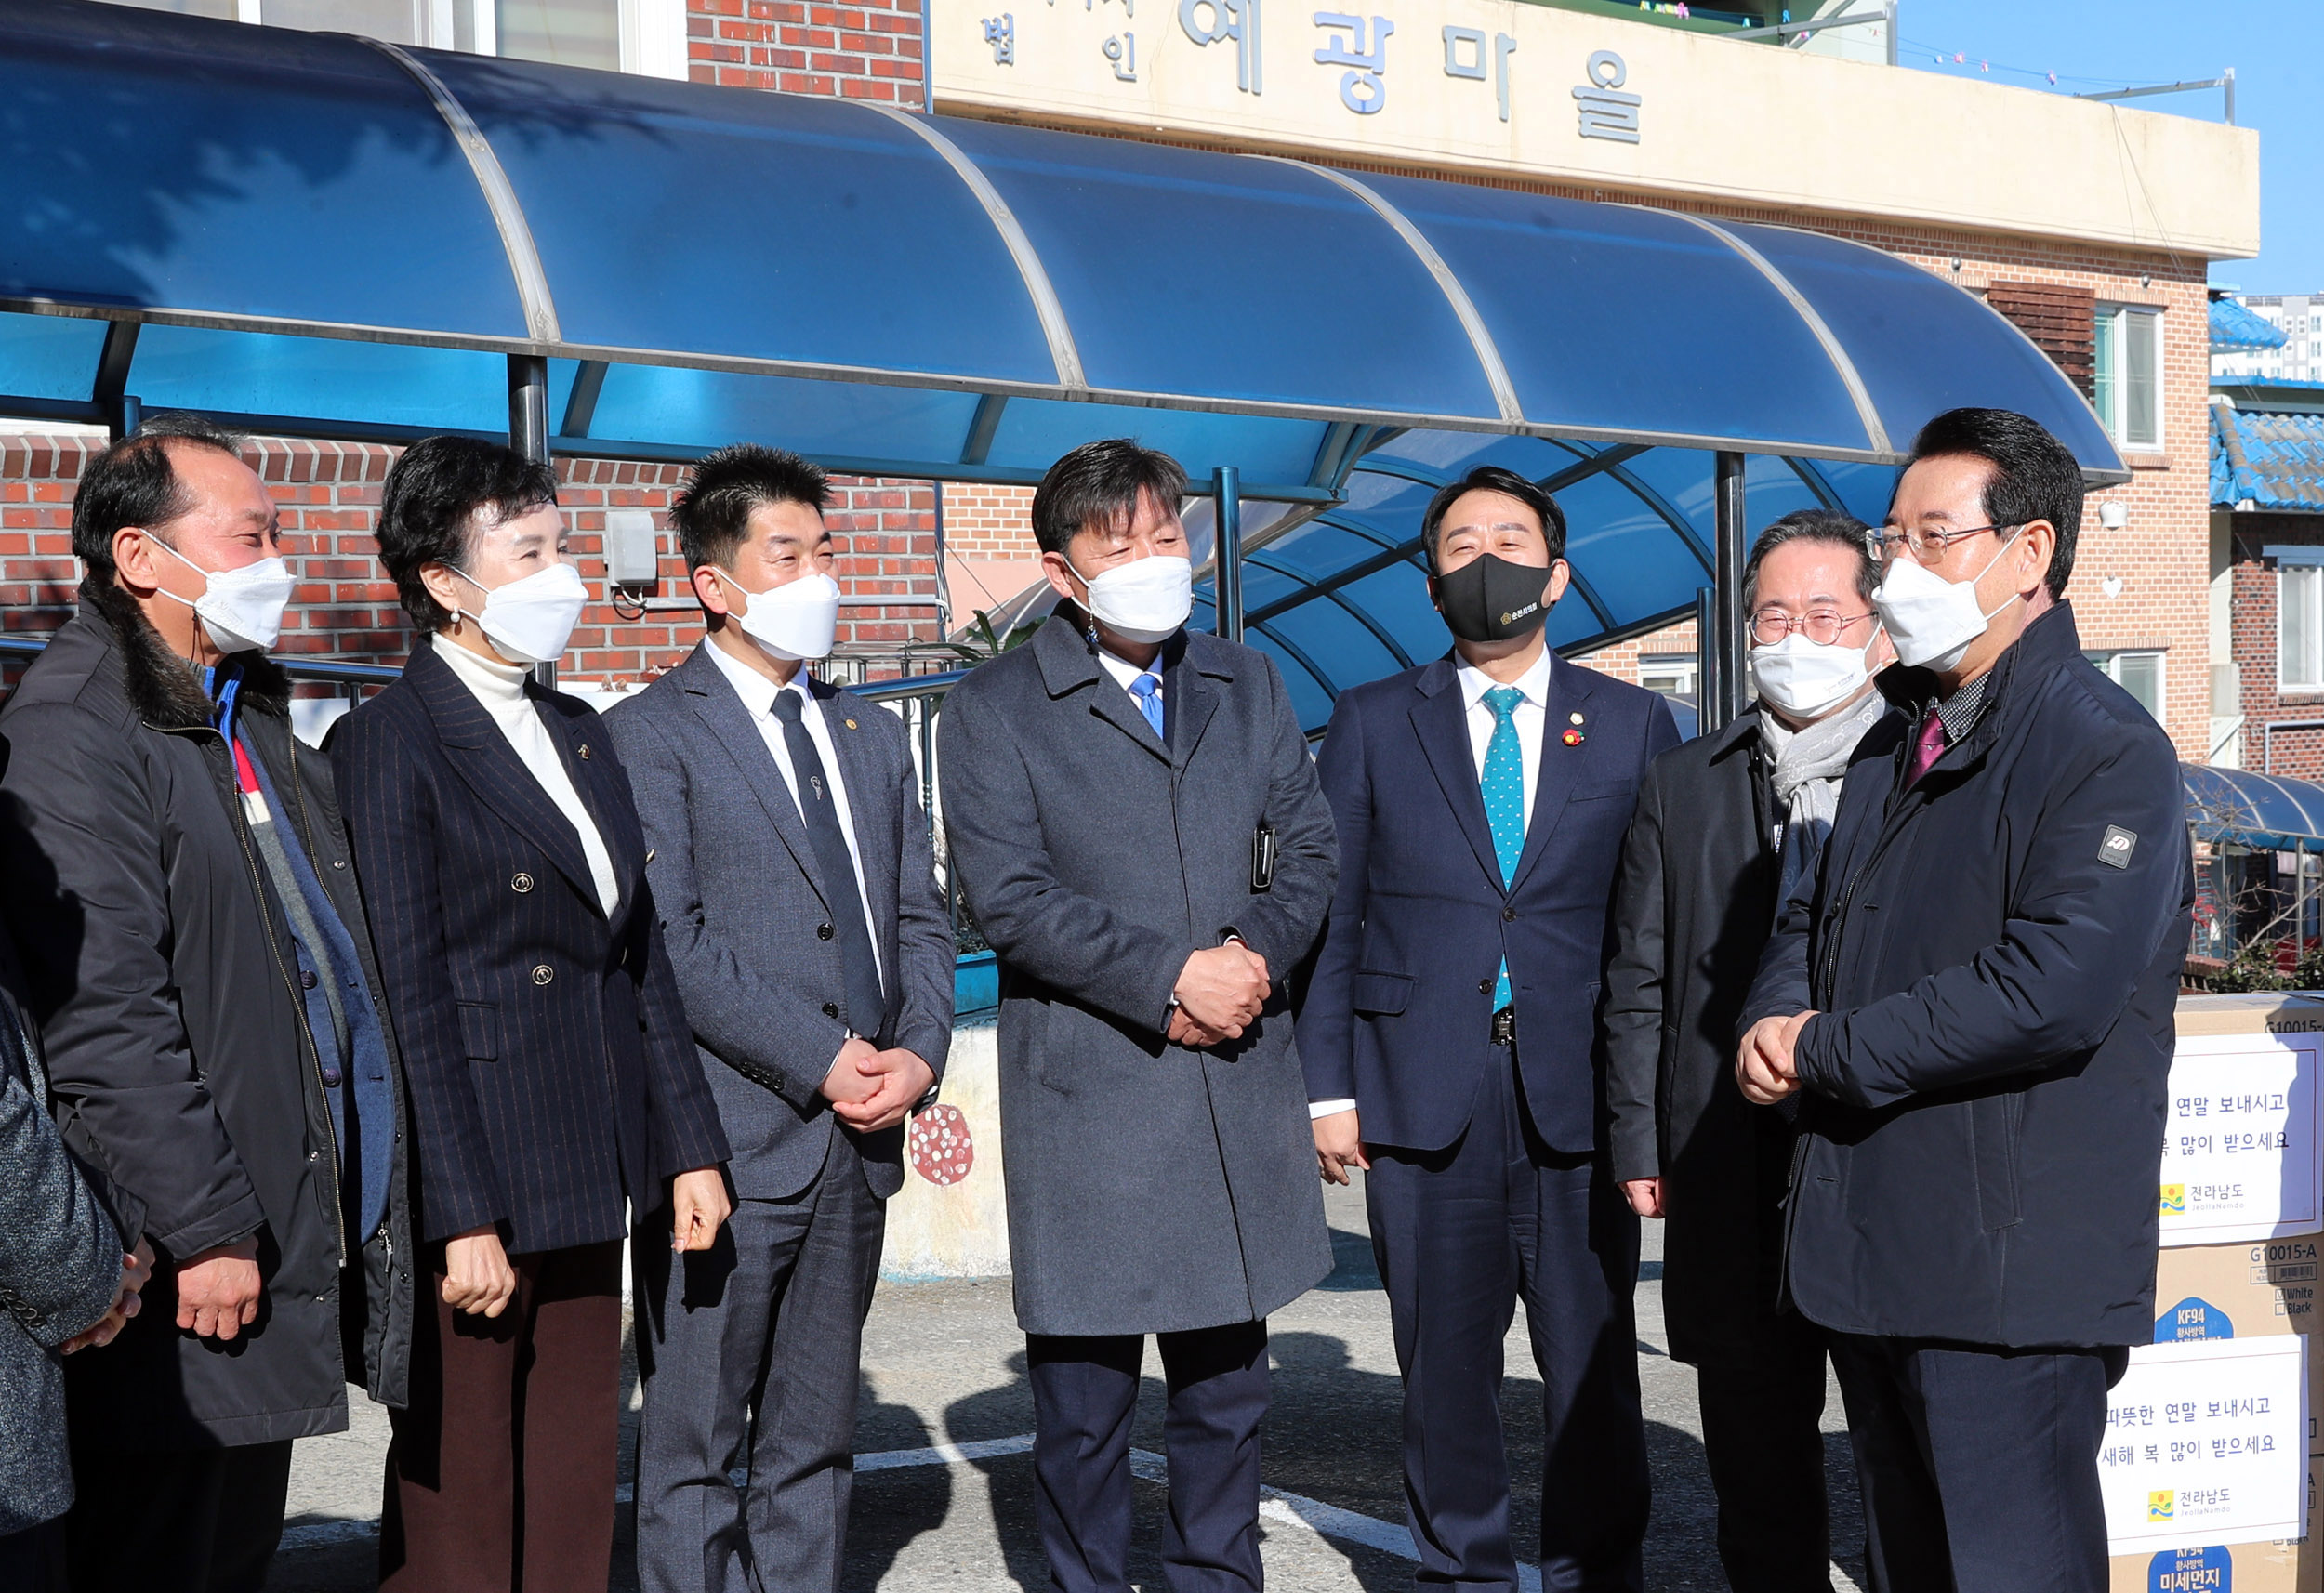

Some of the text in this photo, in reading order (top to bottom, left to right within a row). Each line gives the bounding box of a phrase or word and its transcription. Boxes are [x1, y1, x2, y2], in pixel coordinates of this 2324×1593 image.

[1178, 0, 1643, 145] 예광마을
[2265, 1020, 2324, 1033] G10015-
[2176, 1094, 2285, 1117] 연말 보내시고
[2181, 1135, 2212, 1155] 많이
[2225, 1132, 2289, 1153] 받으세요
[2191, 1184, 2244, 1201] 전라남도
[2251, 1244, 2317, 1262] G10015-A
[2287, 1287, 2313, 1299] White
[2177, 1308, 2205, 1325] KF94
[2287, 1302, 2311, 1314] Black
[2106, 1398, 2270, 1427] 따뜻한 연말 보내시고
[2102, 1435, 2275, 1467] 새해 복 많이 받으세요
[2180, 1488, 2230, 1507] 전라남도
[2160, 1568, 2220, 1593] 미세먼지
